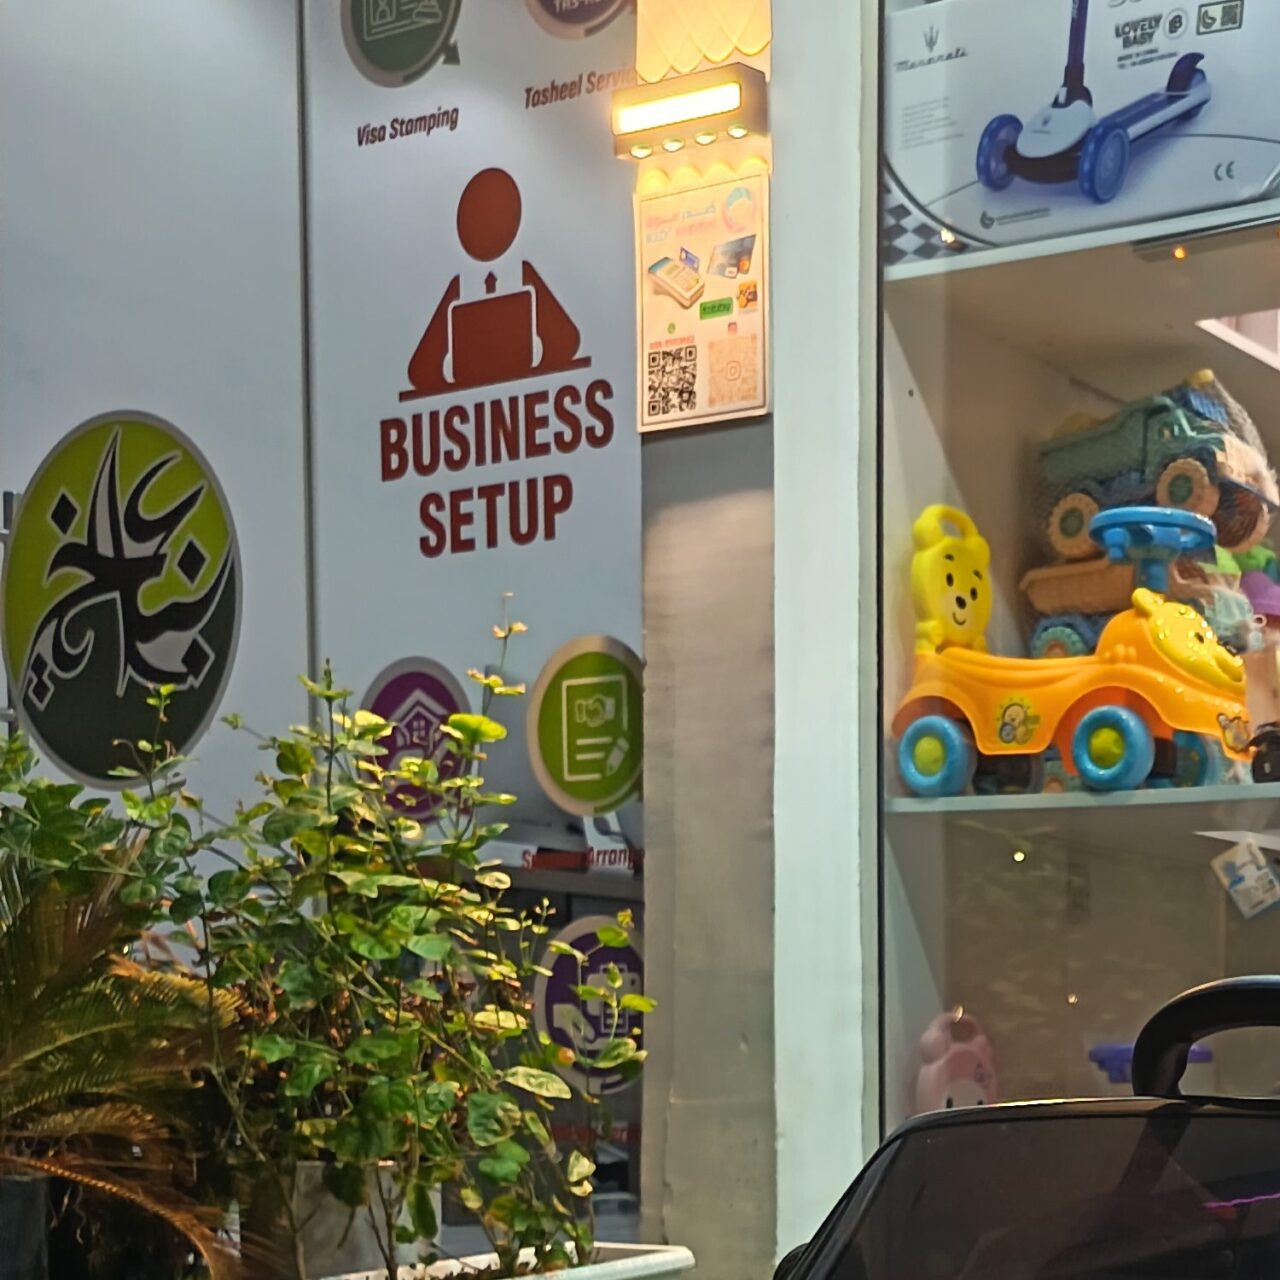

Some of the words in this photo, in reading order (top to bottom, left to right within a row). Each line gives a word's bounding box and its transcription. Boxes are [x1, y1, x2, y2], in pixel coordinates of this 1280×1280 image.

[524, 72, 583, 110] Tasheel
[357, 123, 387, 147] Visa
[389, 105, 460, 141] Stamping
[379, 378, 615, 482] BUSINESS
[418, 473, 574, 558] SETUP
